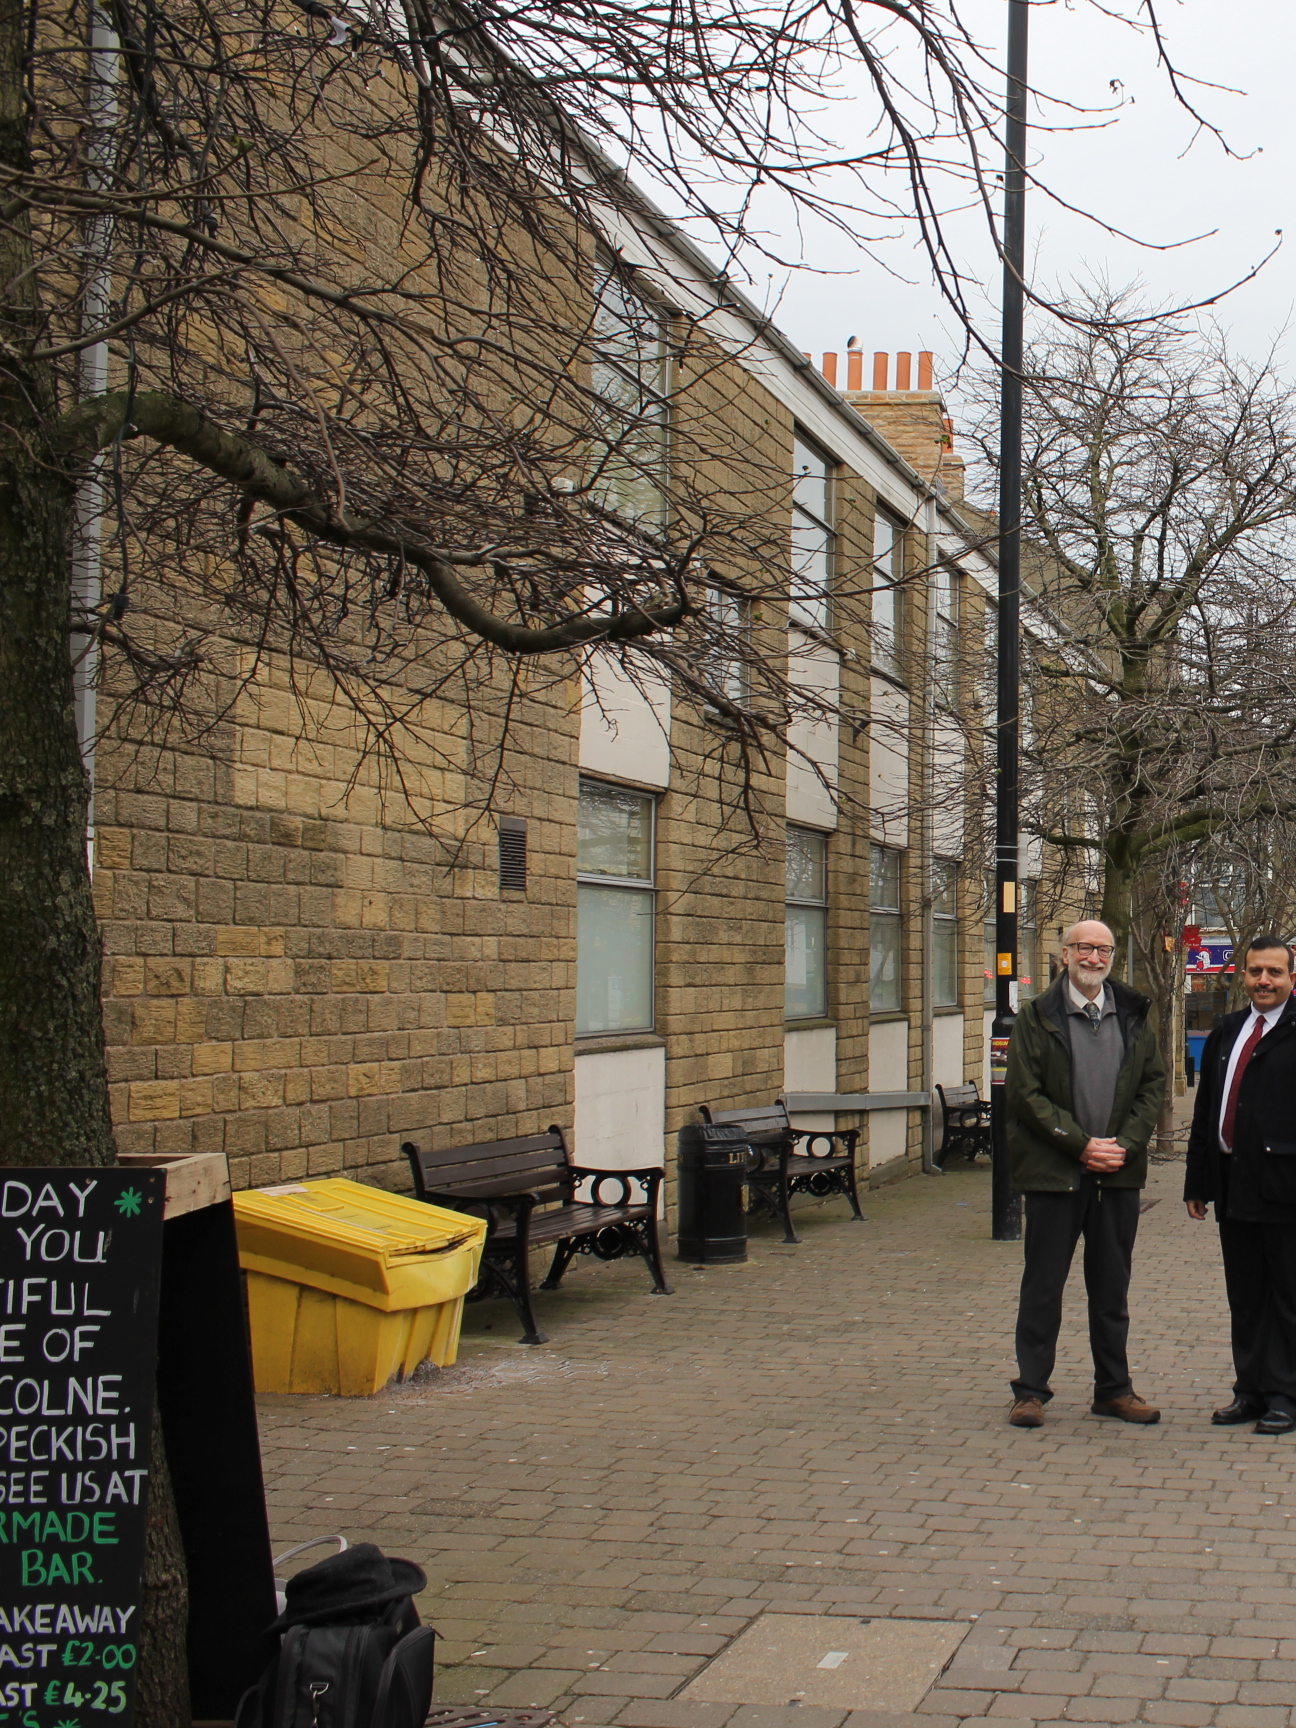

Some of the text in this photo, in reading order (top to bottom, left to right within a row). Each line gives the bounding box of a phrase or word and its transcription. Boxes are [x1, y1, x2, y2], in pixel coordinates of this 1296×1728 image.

[2, 1180, 98, 1217] DAY
[17, 1223, 107, 1263] YOU
[0, 1278, 112, 1316] IFUL
[43, 1325, 101, 1362] OF
[0, 1375, 131, 1416] COLNE.
[21, 1549, 103, 1586] BAR.
